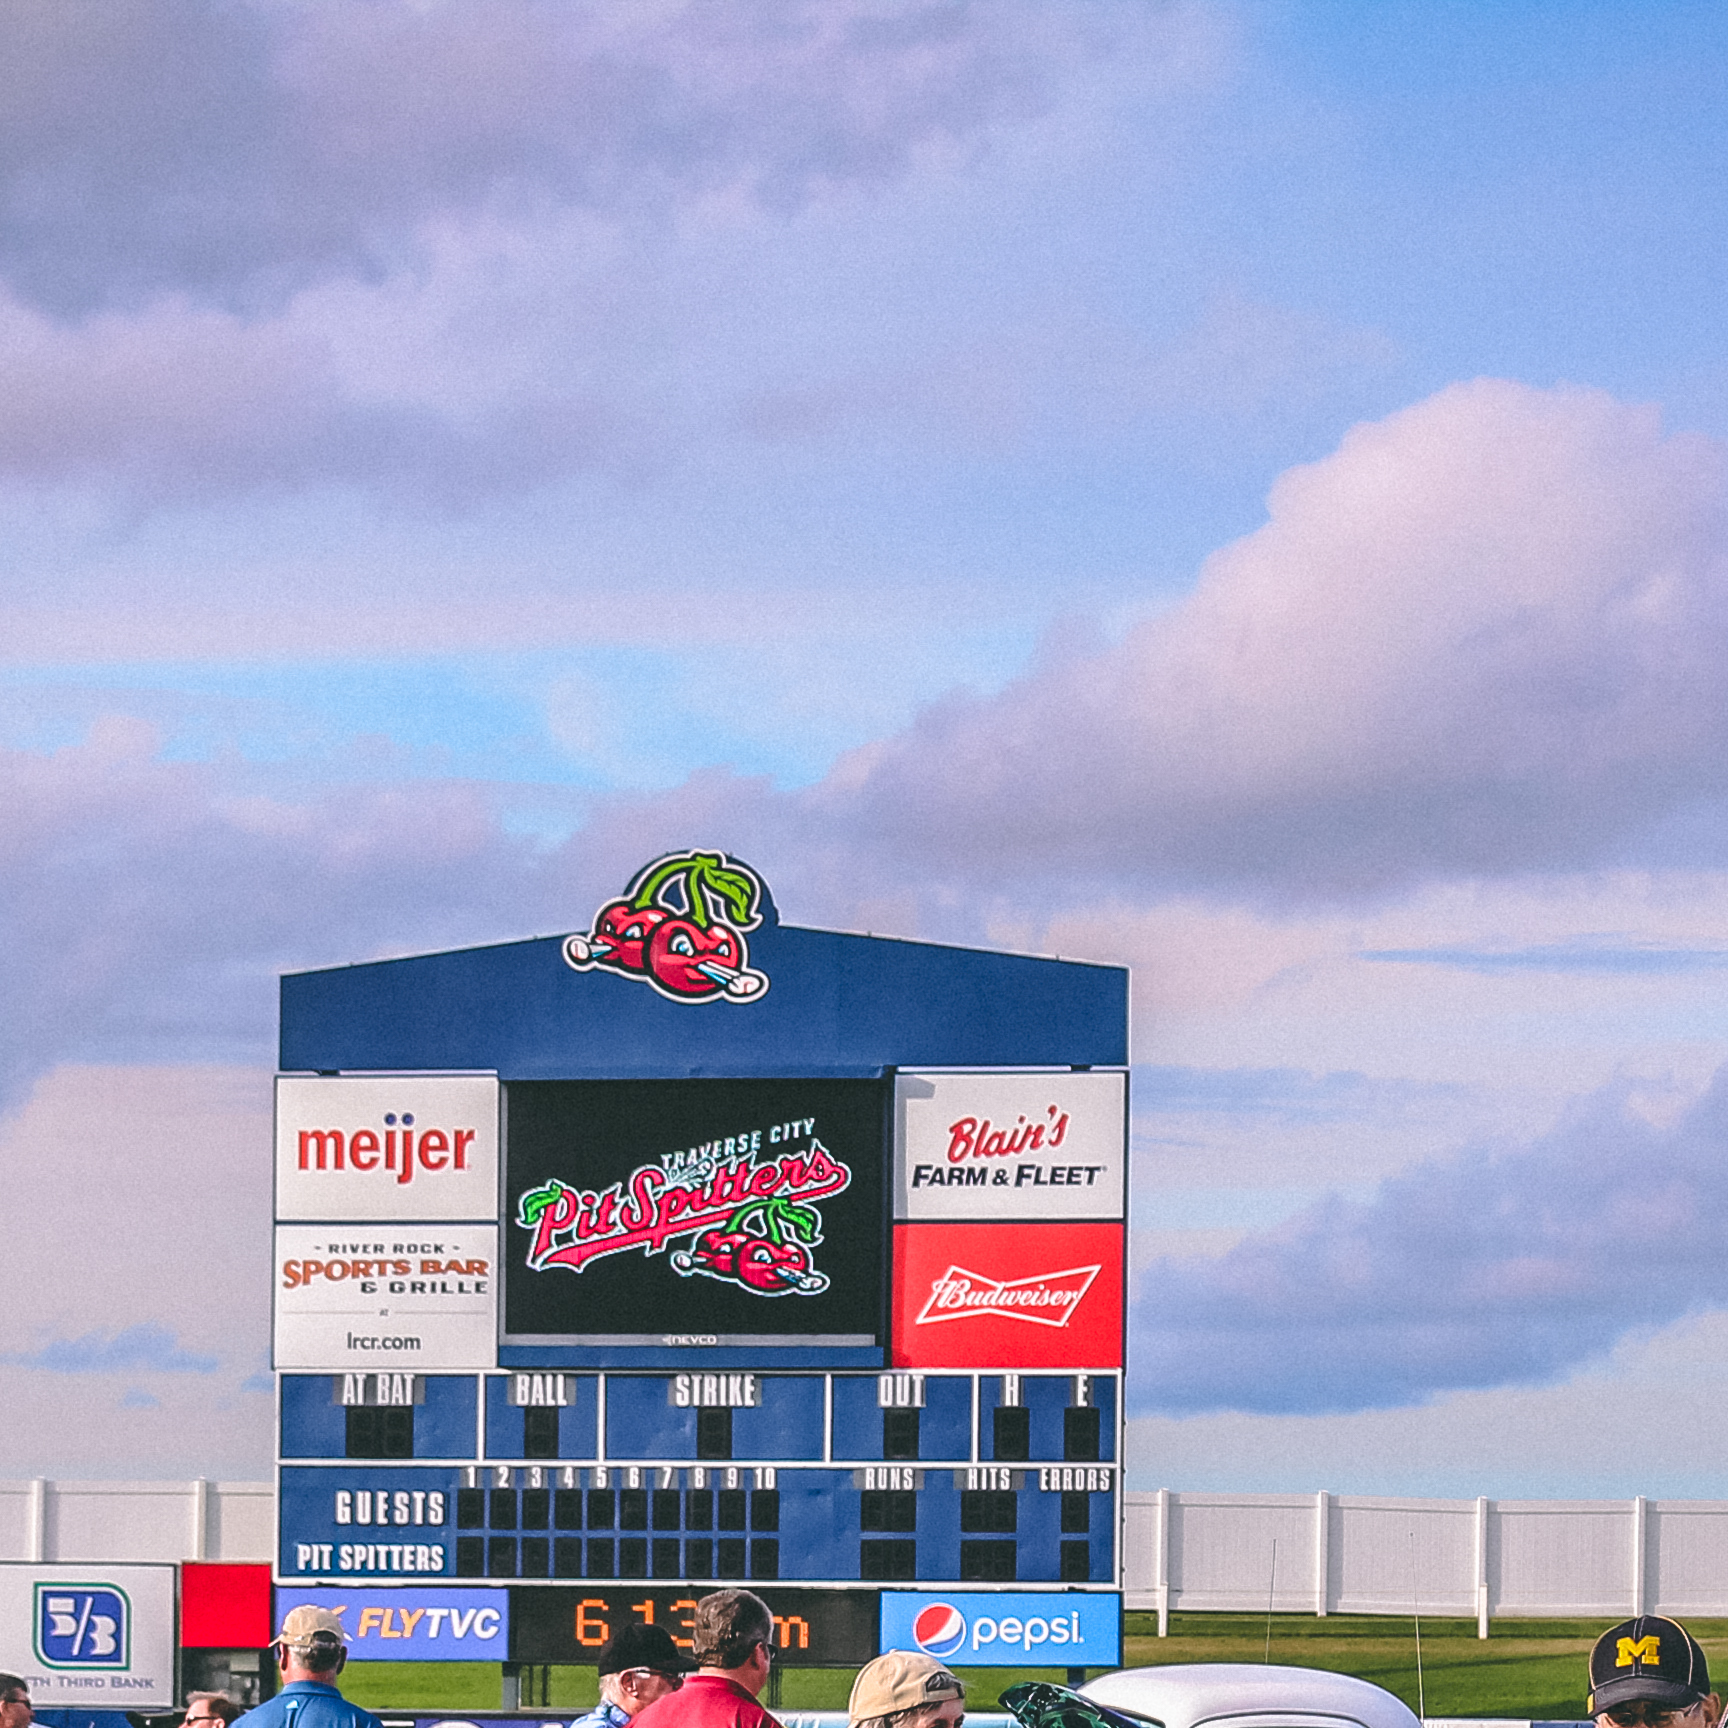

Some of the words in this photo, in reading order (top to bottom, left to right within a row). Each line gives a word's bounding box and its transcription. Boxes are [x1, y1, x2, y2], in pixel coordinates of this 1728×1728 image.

[298, 1112, 476, 1184] meijer
[662, 1130, 762, 1171] TRAVERSE
[770, 1117, 815, 1144] CITY
[947, 1104, 1070, 1163] Blain's
[912, 1165, 988, 1187] FARM
[992, 1168, 1010, 1186] &
[1014, 1164, 1101, 1188] FLEET
[328, 1243, 385, 1254] RIVER
[393, 1243, 445, 1254] ROCK
[282, 1259, 412, 1289] SPORTS
[420, 1259, 489, 1277] BAR
[389, 1281, 488, 1294] GRILLE
[932, 1279, 1080, 1309] Budweiser
[342, 1374, 367, 1406] AT
[377, 1374, 416, 1406] BAT
[516, 1374, 568, 1406] BALL
[675, 1374, 755, 1406] STRIKE
[878, 1374, 925, 1407] OUT
[1004, 1374, 1019, 1406] H
[1076, 1374, 1089, 1406] E
[467, 1467, 477, 1489] 1
[499, 1467, 510, 1489] 2
[531, 1467, 542, 1489] 3
[563, 1467, 575, 1489] 4
[596, 1467, 608, 1489] 5
[629, 1467, 640, 1489] 6
[662, 1467, 673, 1489] 7
[694, 1467, 705, 1489] 8
[727, 1467, 738, 1489] 9
[755, 1467, 775, 1489] 10
[865, 1467, 914, 1490] RUNS
[968, 1467, 1011, 1490] HITS
[1040, 1468, 1110, 1492] ERRORS
[335, 1490, 444, 1525] GUESTS
[297, 1544, 333, 1571] PIT
[340, 1544, 444, 1572] SPITTERS
[357, 1607, 501, 1640] FLYTVC
[1615, 1634, 1661, 1668] M
[58, 1676, 105, 1688] THIRD
[111, 1677, 155, 1689] BANK
